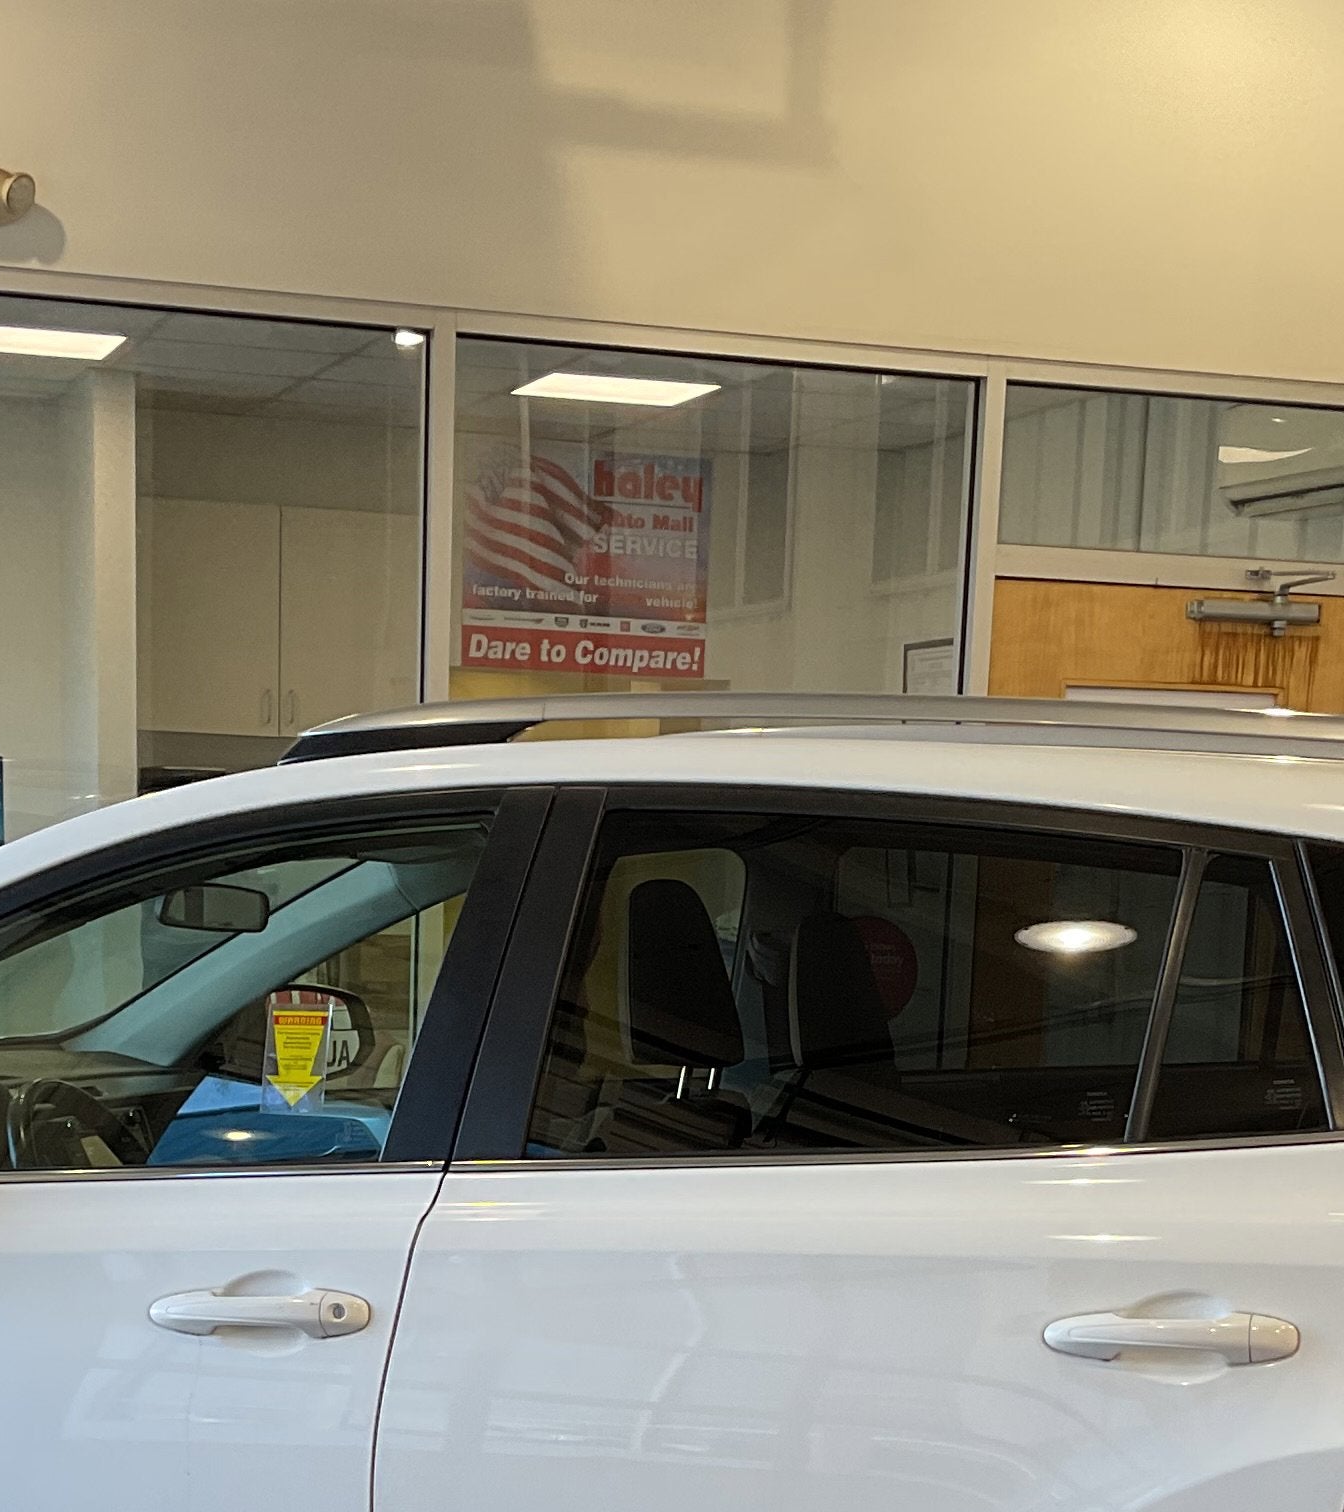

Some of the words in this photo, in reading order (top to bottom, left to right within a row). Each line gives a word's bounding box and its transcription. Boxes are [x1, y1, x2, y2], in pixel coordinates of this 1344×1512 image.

[594, 459, 704, 513] haley
[652, 513, 694, 532] Mall
[593, 533, 698, 559] SERVICE
[565, 572, 590, 586] Our
[472, 584, 521, 600] factory
[526, 586, 575, 601] trained
[579, 590, 599, 603] for
[469, 633, 532, 661] Dare
[540, 638, 566, 663] to
[574, 640, 701, 673] Compare!
